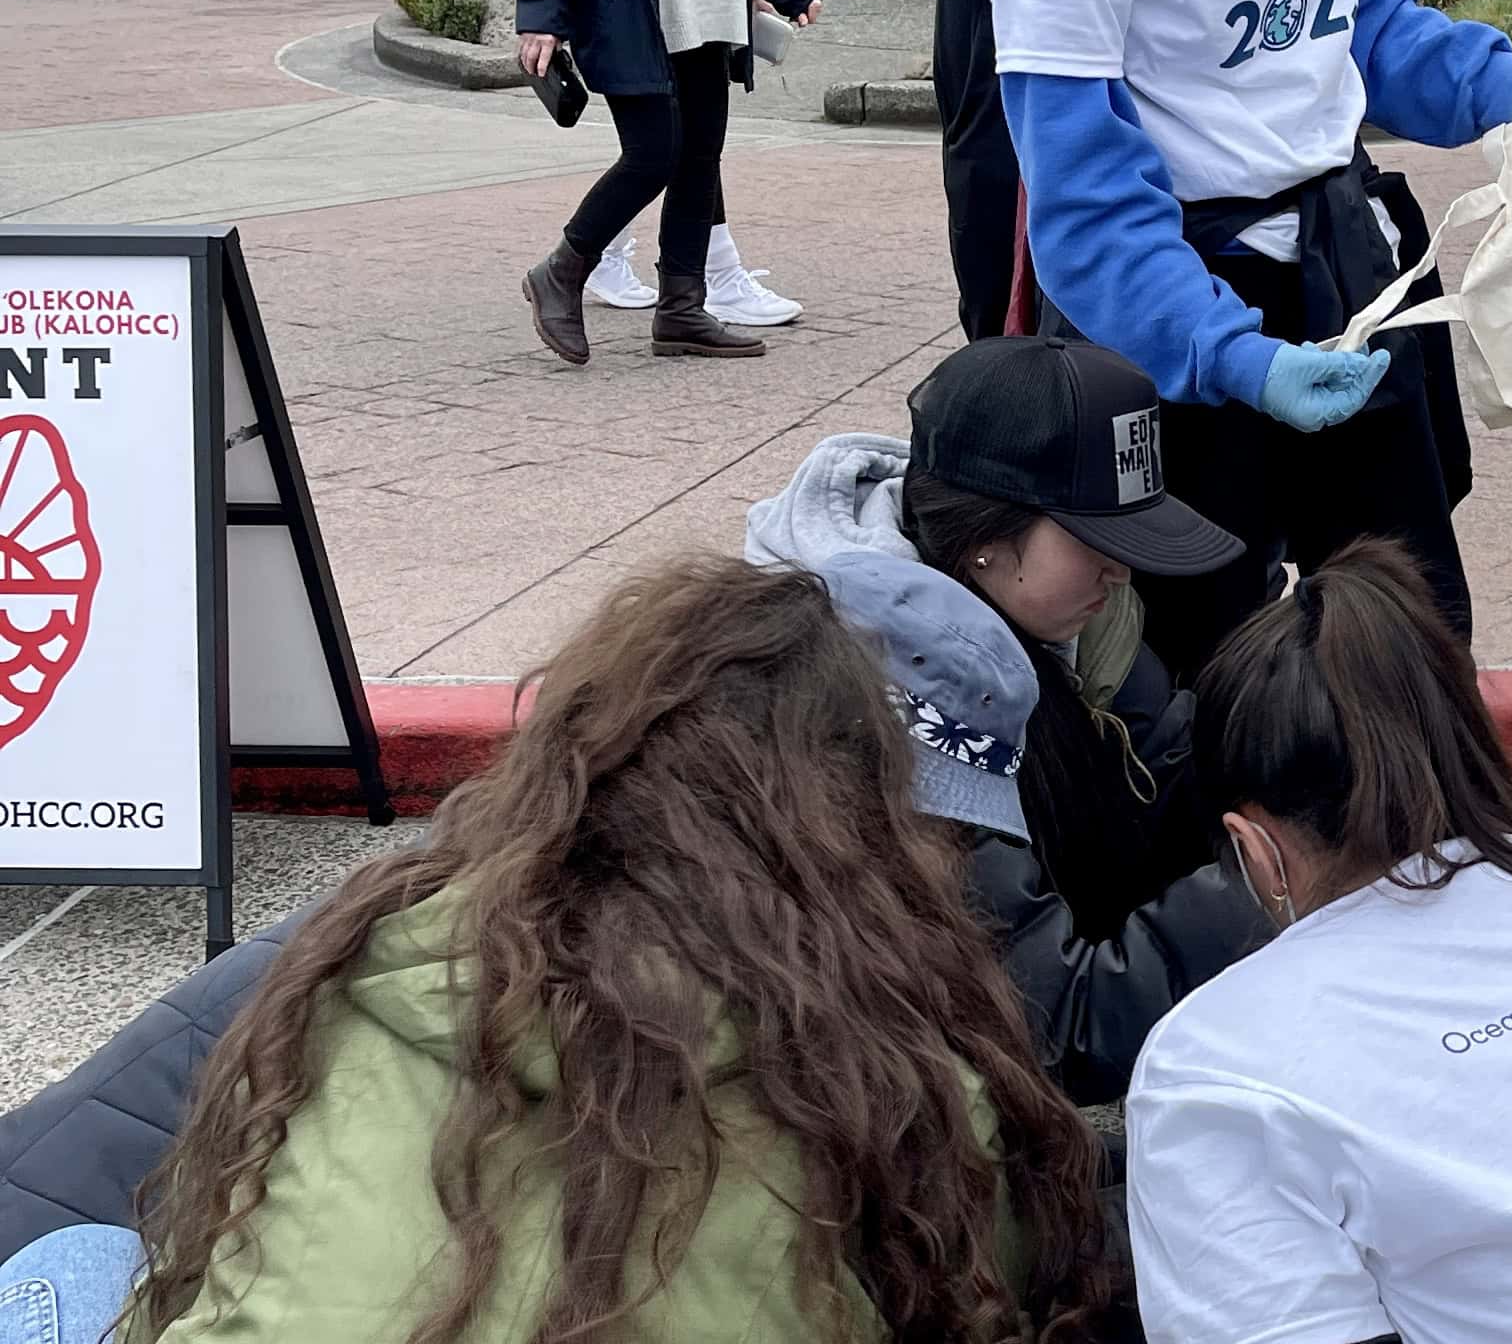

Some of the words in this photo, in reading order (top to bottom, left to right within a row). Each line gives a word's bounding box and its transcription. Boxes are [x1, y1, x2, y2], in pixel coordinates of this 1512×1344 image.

[0, 315, 25, 335] UB
[35, 314, 179, 340] (KALOHCC)
[0, 348, 110, 399] NT
[0, 801, 164, 829] HCC.ORG
